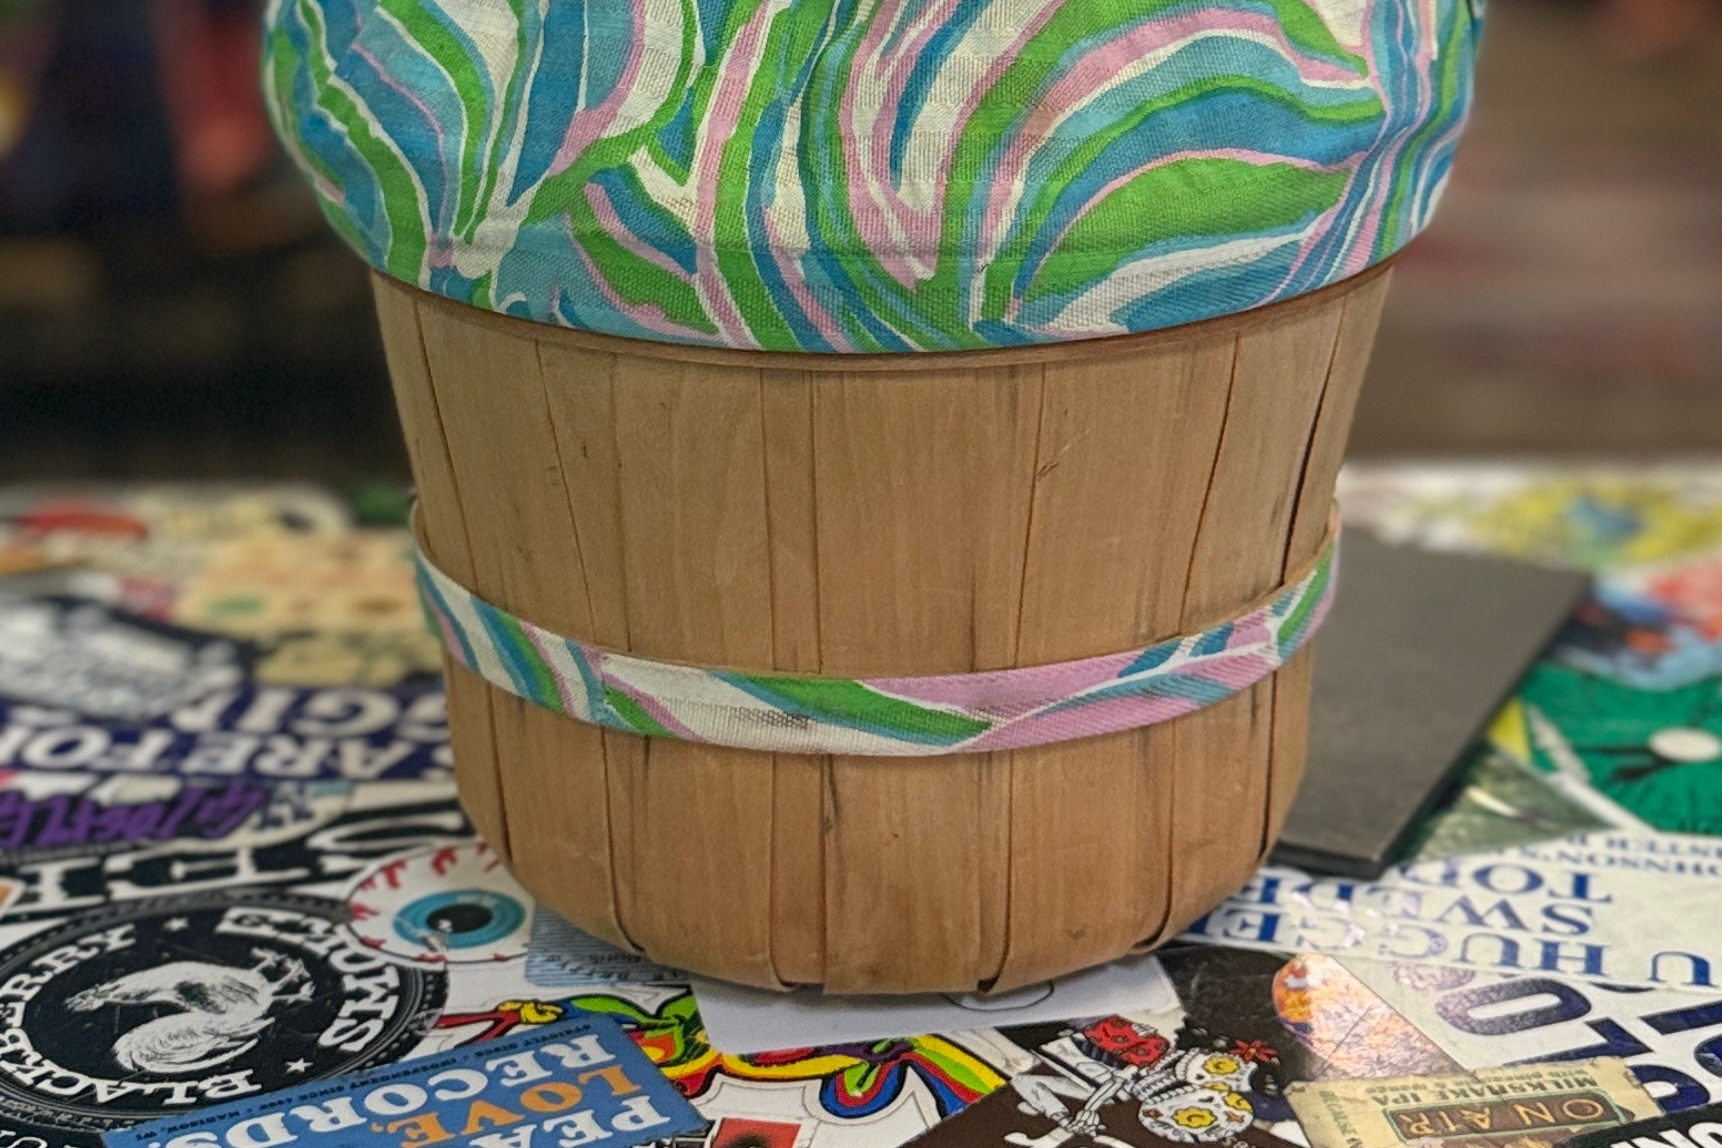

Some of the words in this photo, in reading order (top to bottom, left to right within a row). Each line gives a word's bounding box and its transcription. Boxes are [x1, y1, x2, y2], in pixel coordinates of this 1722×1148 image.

[181, 733, 412, 780] ARE
[1186, 905, 1609, 978] HUGGE
[1370, 1091, 1422, 1107] IPA
[1434, 1076, 1597, 1102] MILKSHAKE
[369, 1064, 642, 1148] LOVE,
[1398, 1106, 1491, 1136] AIR
[1512, 1097, 1605, 1126] ON
